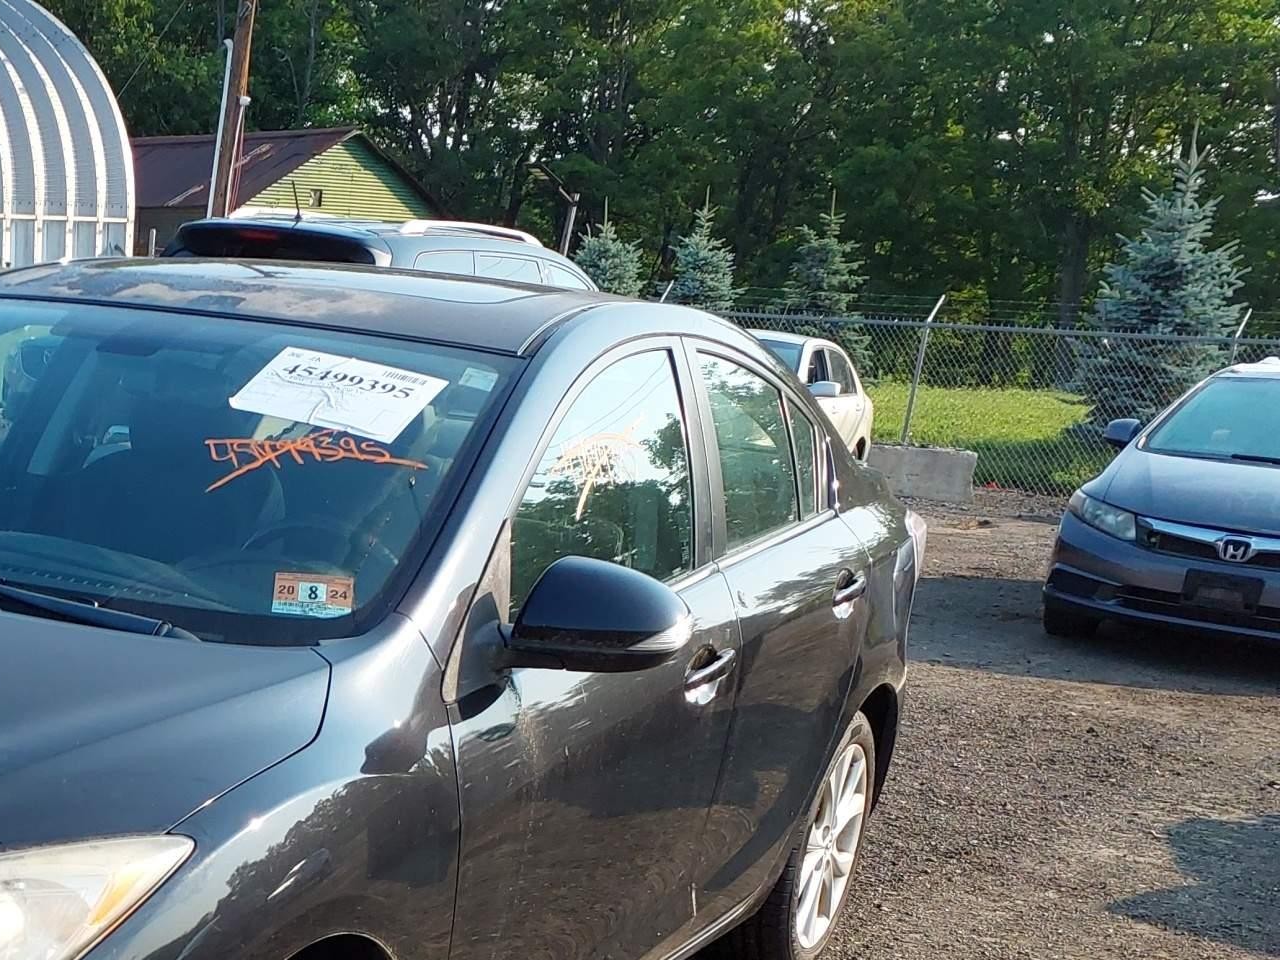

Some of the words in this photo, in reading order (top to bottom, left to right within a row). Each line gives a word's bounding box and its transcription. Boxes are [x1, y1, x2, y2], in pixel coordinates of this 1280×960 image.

[282, 363, 414, 399] 45499395
[277, 584, 296, 596] 20
[307, 585, 319, 600] 8
[329, 589, 348, 601] 24
